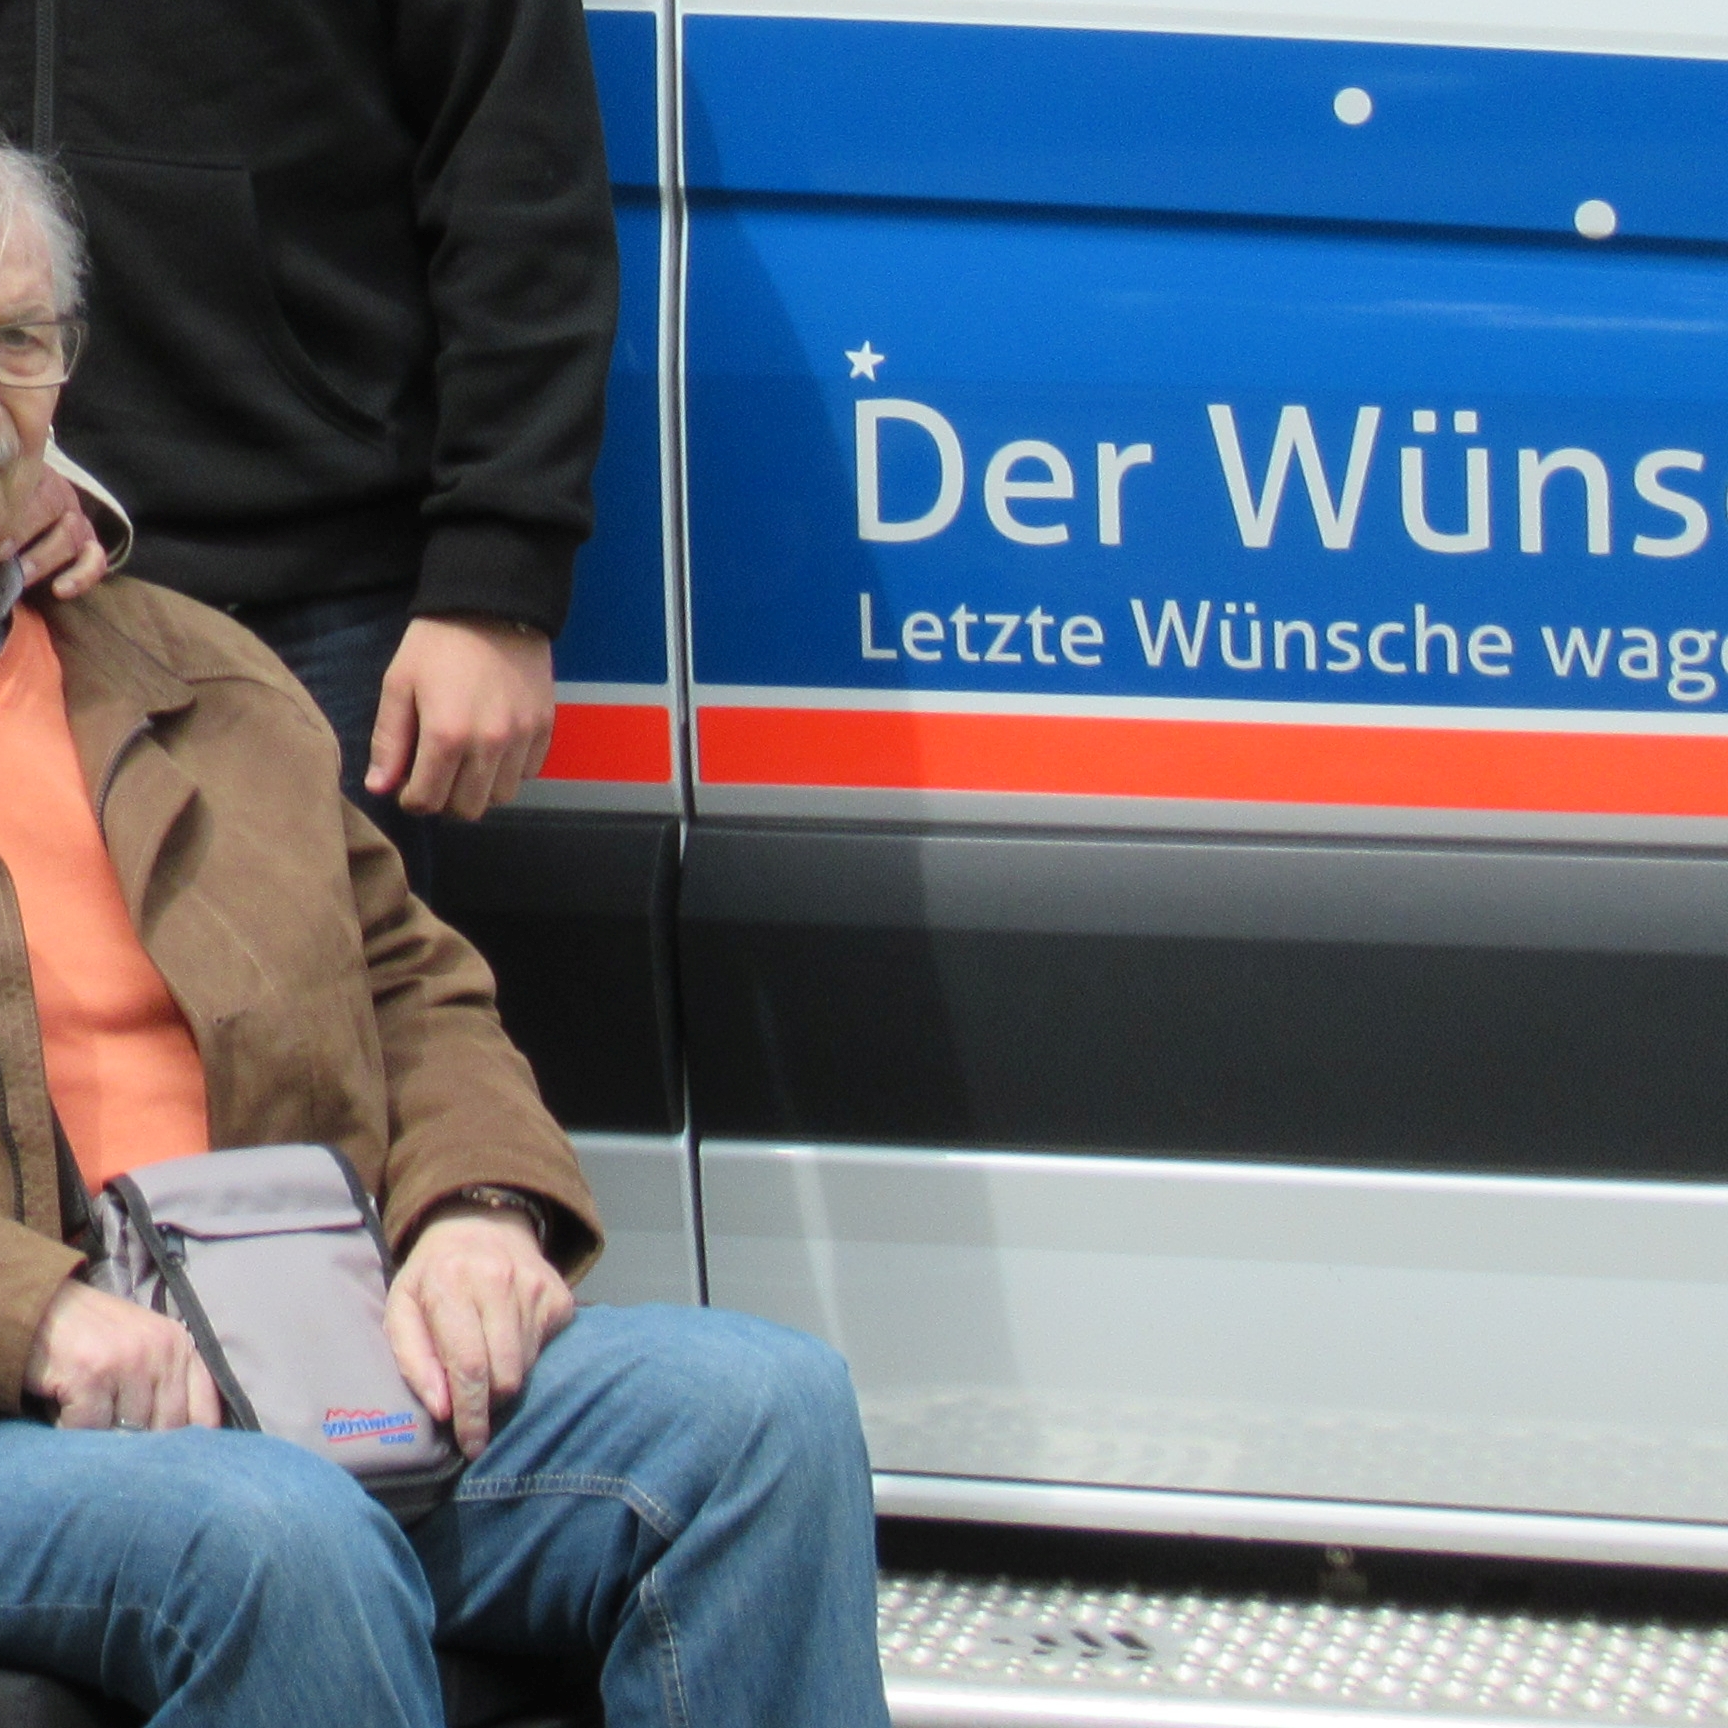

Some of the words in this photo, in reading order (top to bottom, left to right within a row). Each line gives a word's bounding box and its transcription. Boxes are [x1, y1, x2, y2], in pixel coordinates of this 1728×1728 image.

[854, 398, 1153, 547] Der
[1206, 403, 1728, 559] Wüns
[859, 593, 1105, 667] Letzte
[1130, 599, 1514, 677] Wünsche
[1540, 626, 1728, 704] wag
